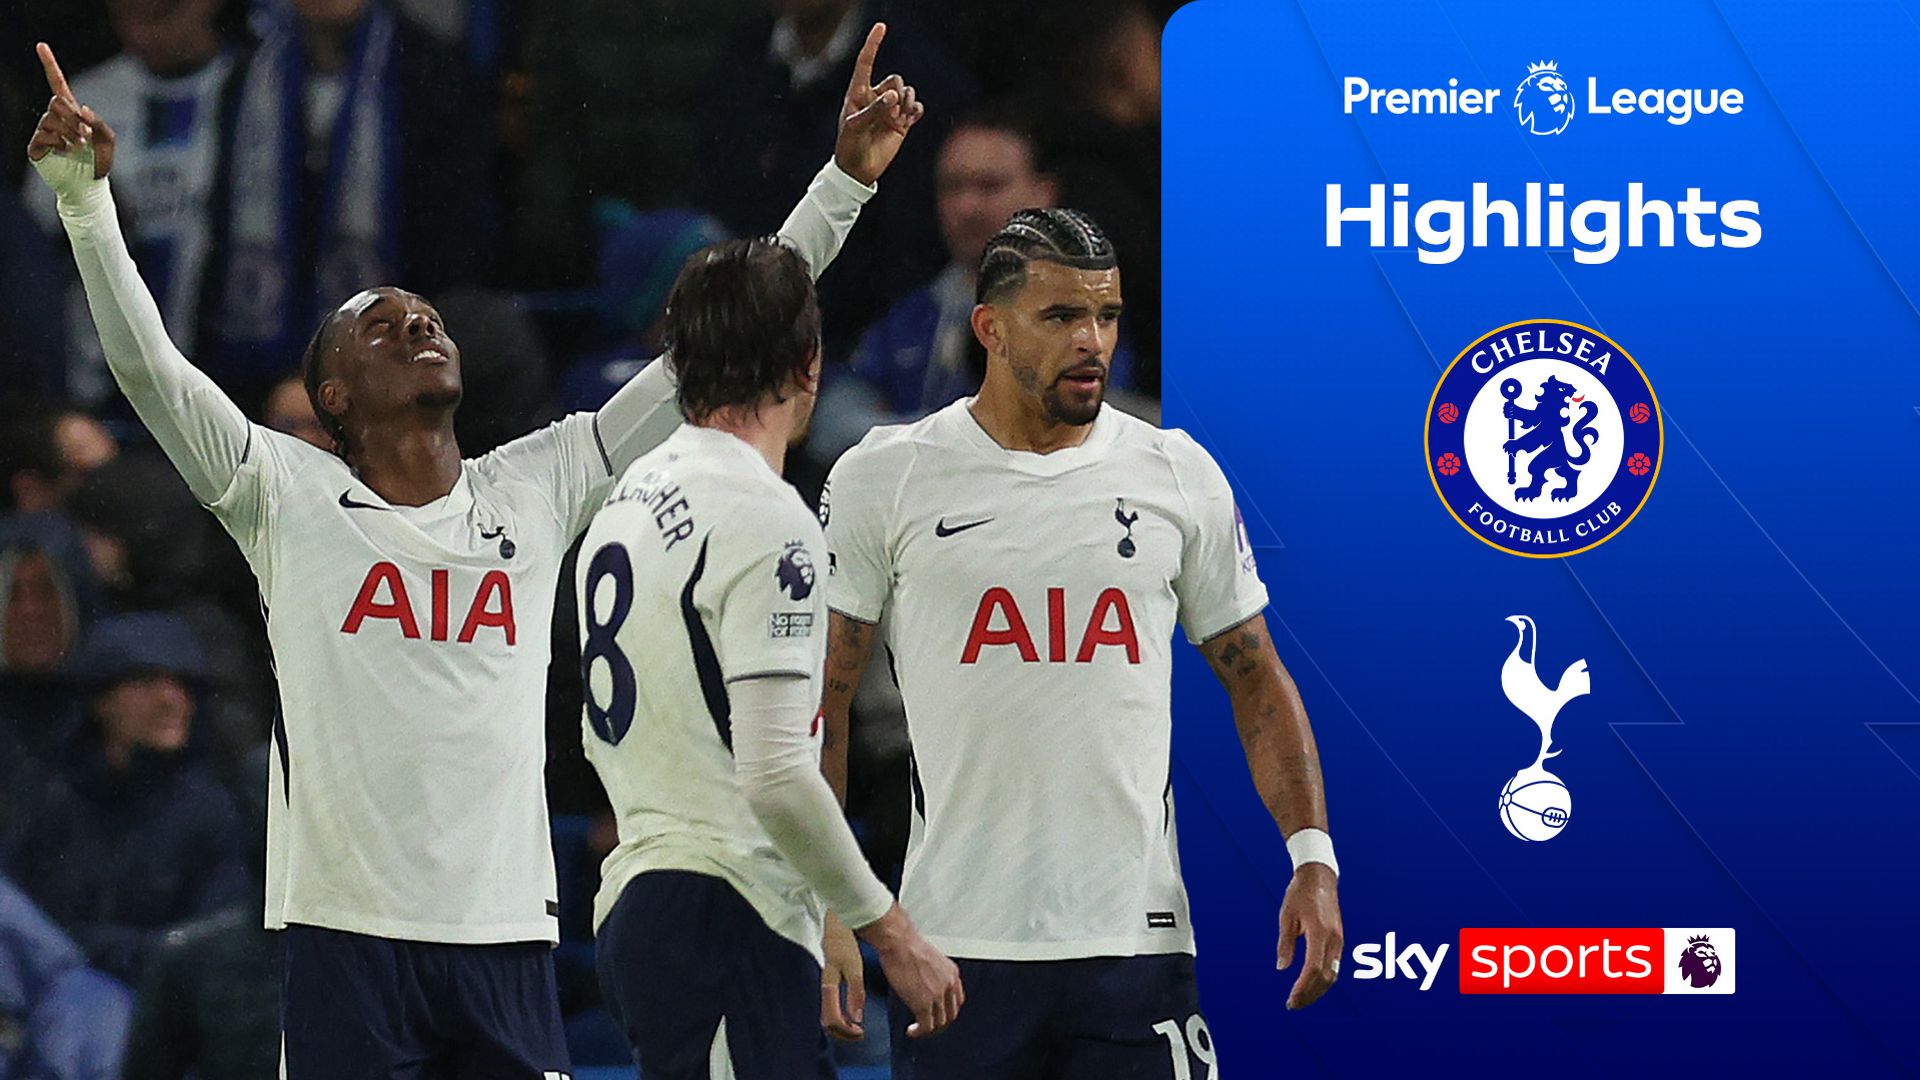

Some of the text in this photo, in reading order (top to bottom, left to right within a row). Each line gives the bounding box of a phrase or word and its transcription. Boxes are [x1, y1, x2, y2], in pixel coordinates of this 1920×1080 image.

[340, 561, 517, 646] AIA
[581, 541, 637, 747] 8
[960, 587, 1141, 665] AIA
[1151, 1014, 1220, 1080] 19
